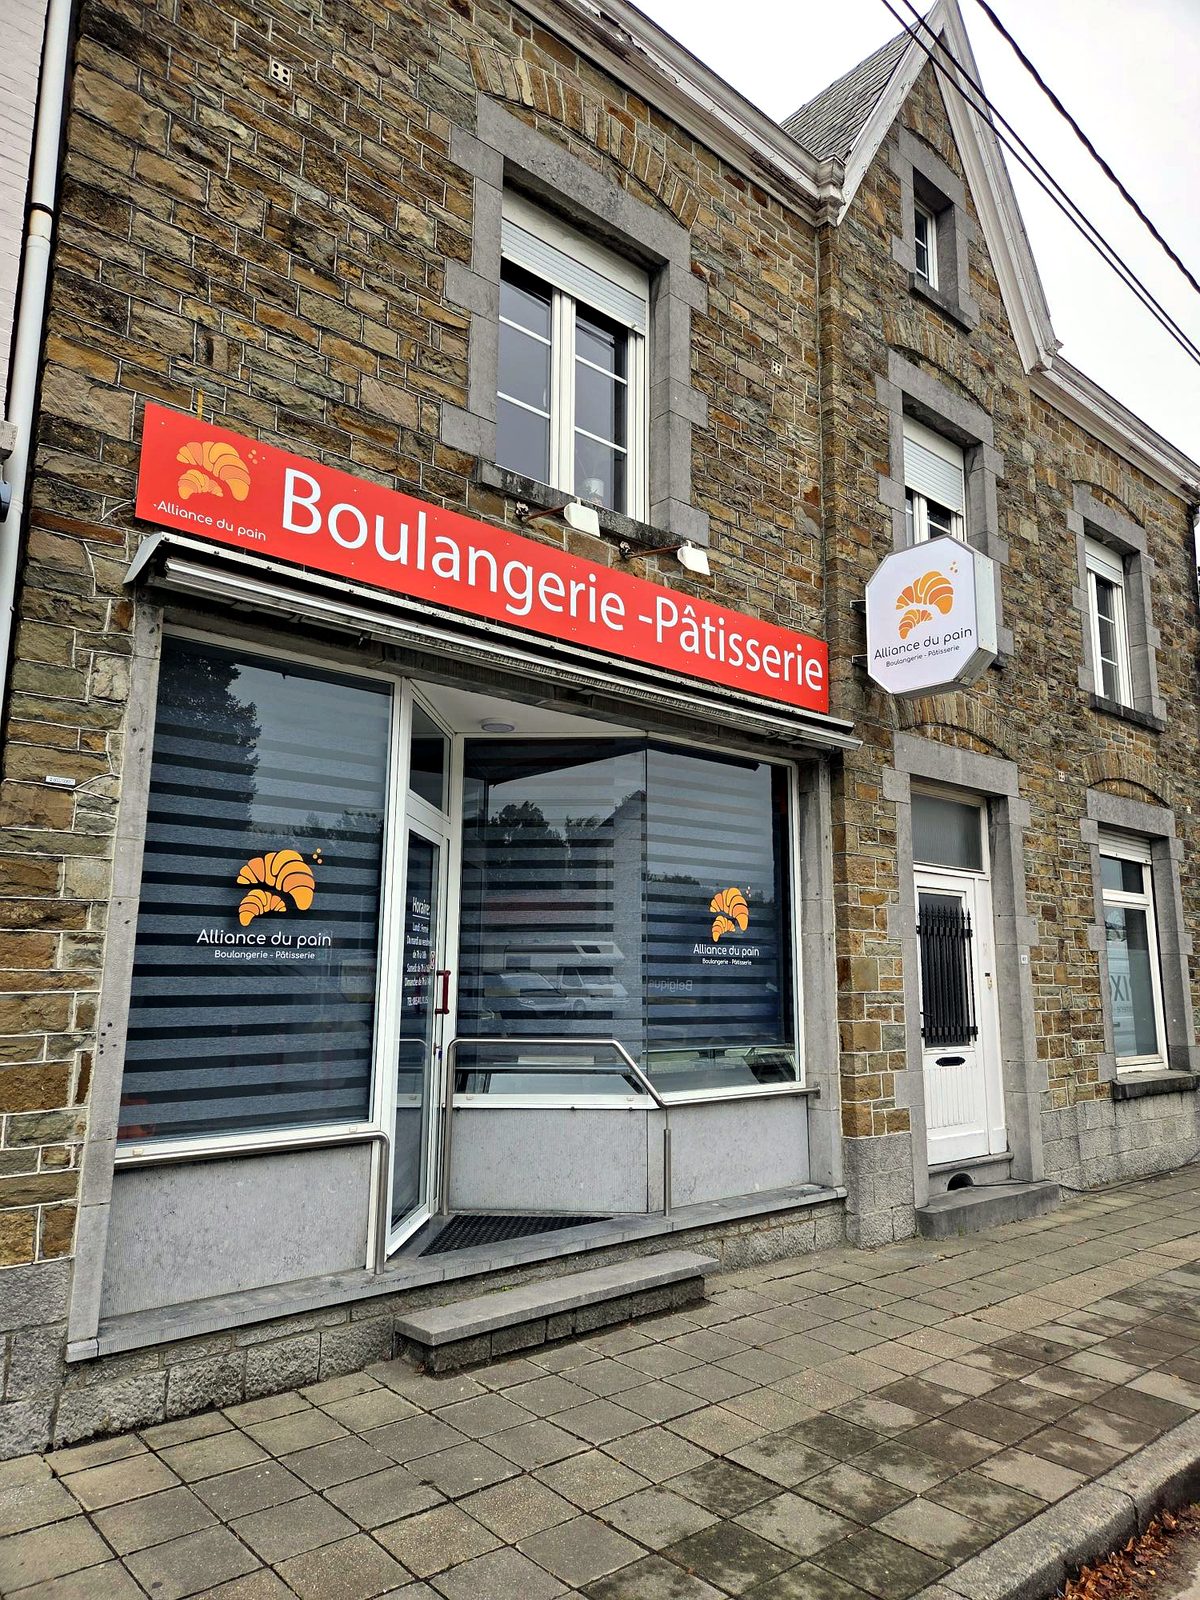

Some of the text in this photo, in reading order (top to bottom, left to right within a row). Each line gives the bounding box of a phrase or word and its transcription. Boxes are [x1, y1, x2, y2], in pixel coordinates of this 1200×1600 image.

[157, 500, 267, 542] Alliance du pain
[282, 468, 626, 631] Boulangerie
[874, 628, 973, 660] Alliance du pain
[885, 654, 923, 668] Boulangerie
[928, 644, 960, 657] Pâtisserie
[196, 929, 332, 949] Alliance du pain
[214, 950, 268, 960] Boulangerie
[275, 950, 316, 959] Pâtisserie
[693, 943, 760, 958] Alliance du pain
[702, 958, 729, 966] Boulangerie
